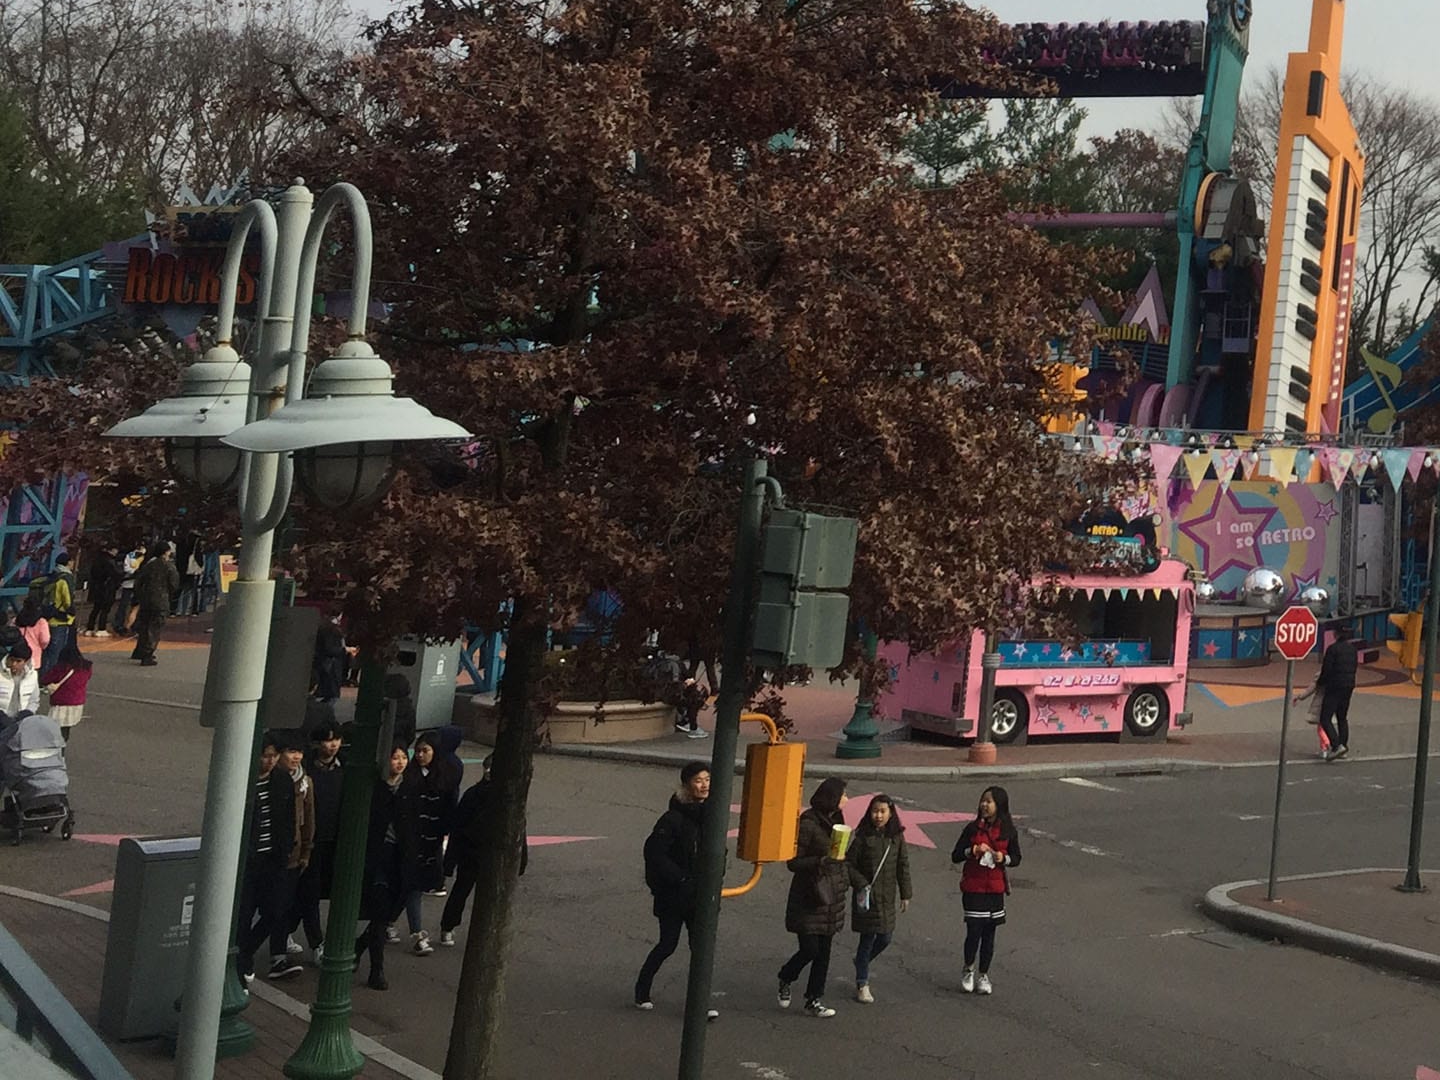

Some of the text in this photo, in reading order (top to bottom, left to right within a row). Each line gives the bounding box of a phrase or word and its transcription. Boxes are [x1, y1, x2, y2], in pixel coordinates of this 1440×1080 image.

[1092, 525, 1118, 536] RETRO
[1216, 521, 1254, 535] I am
[1236, 526, 1316, 549] so RETRO
[1278, 622, 1315, 643] STOP
